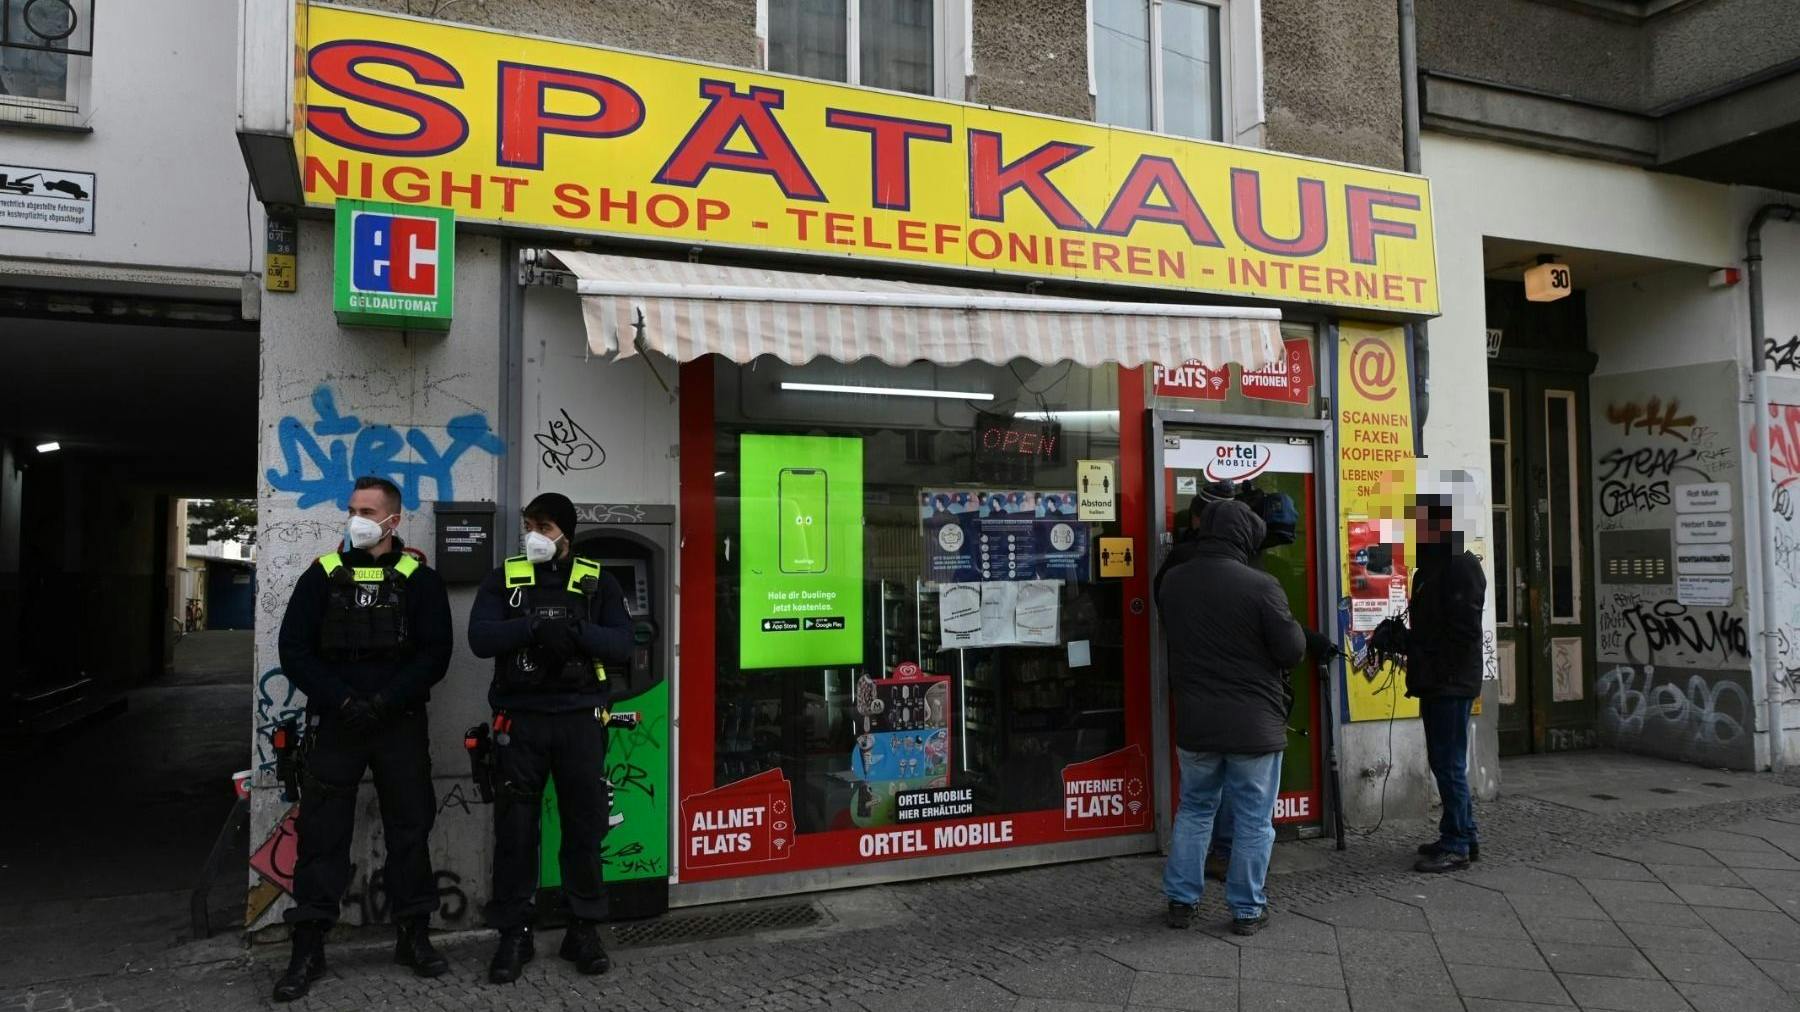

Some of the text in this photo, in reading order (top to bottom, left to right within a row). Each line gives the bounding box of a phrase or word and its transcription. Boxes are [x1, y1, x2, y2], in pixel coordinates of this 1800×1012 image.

[306, 38, 1421, 266] SPÄTKAUF
[305, 156, 529, 212] NIGHT
[552, 183, 731, 231] SHOP
[785, 208, 1185, 280] TELEFONIEREN
[1228, 257, 1427, 304] INTERNET
[1551, 269, 1569, 289] 30
[349, 295, 438, 312] GELDAUTOMAT
[1153, 364, 1207, 390] FLATS
[1350, 337, 1397, 401] @
[1242, 374, 1288, 388] OPTIONEN
[1342, 410, 1408, 428] SCANNEN
[983, 428, 1056, 457] OPEN
[1354, 429, 1399, 445] FAXEN
[1216, 444, 1257, 460] ortel
[1217, 459, 1258, 468] MOBILE
[1081, 499, 1112, 508] Abstand
[768, 590, 837, 600] Hole dir Duolingo
[773, 603, 791, 613] jetzt
[784, 622, 798, 630] Store
[1066, 778, 1124, 795] INTERNET
[898, 789, 973, 807] ORTEL MOBILE
[1065, 794, 1124, 819] FLATS
[898, 803, 973, 820] HIER ERHÄLTLICH
[1273, 797, 1309, 818] BILE
[691, 807, 766, 832] ALLNET
[691, 833, 752, 857] FLATS
[859, 820, 1014, 857] ORTEL MOBILE
